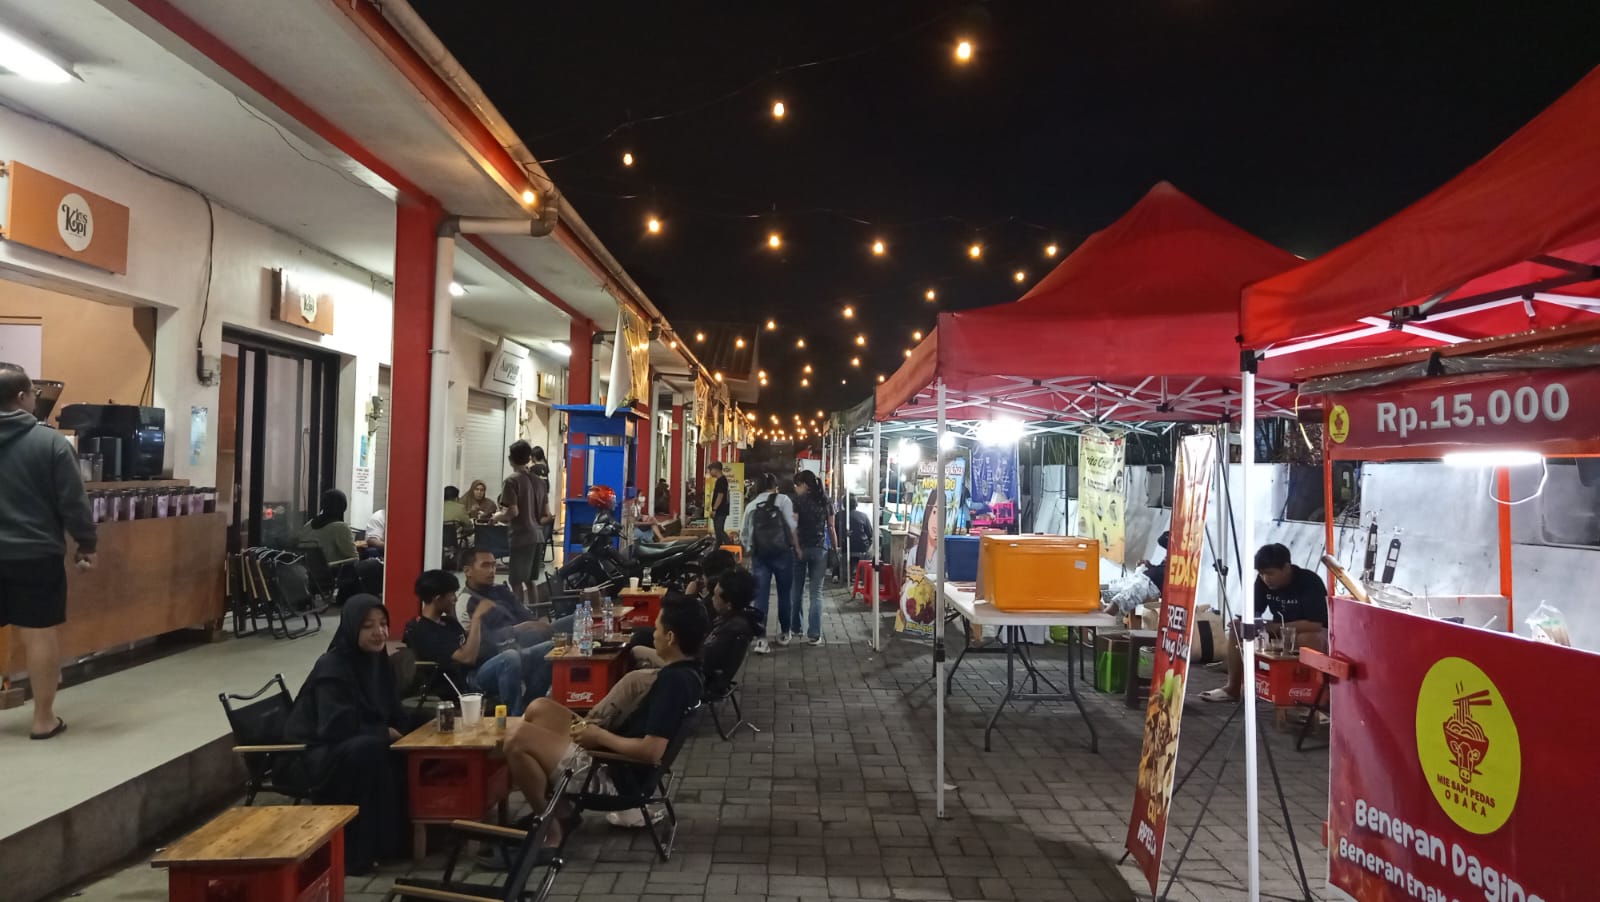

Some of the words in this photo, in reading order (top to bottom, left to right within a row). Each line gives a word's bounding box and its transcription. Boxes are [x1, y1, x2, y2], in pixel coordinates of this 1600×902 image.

[1376, 383, 1570, 438] Rp.15.000
[1168, 554, 1198, 588] EDAS
[1470, 788, 1496, 808] PEDAS
[1339, 837, 1404, 889] Beneran
[1355, 799, 1447, 867] Beneran
[1452, 843, 1545, 902] Dagin
